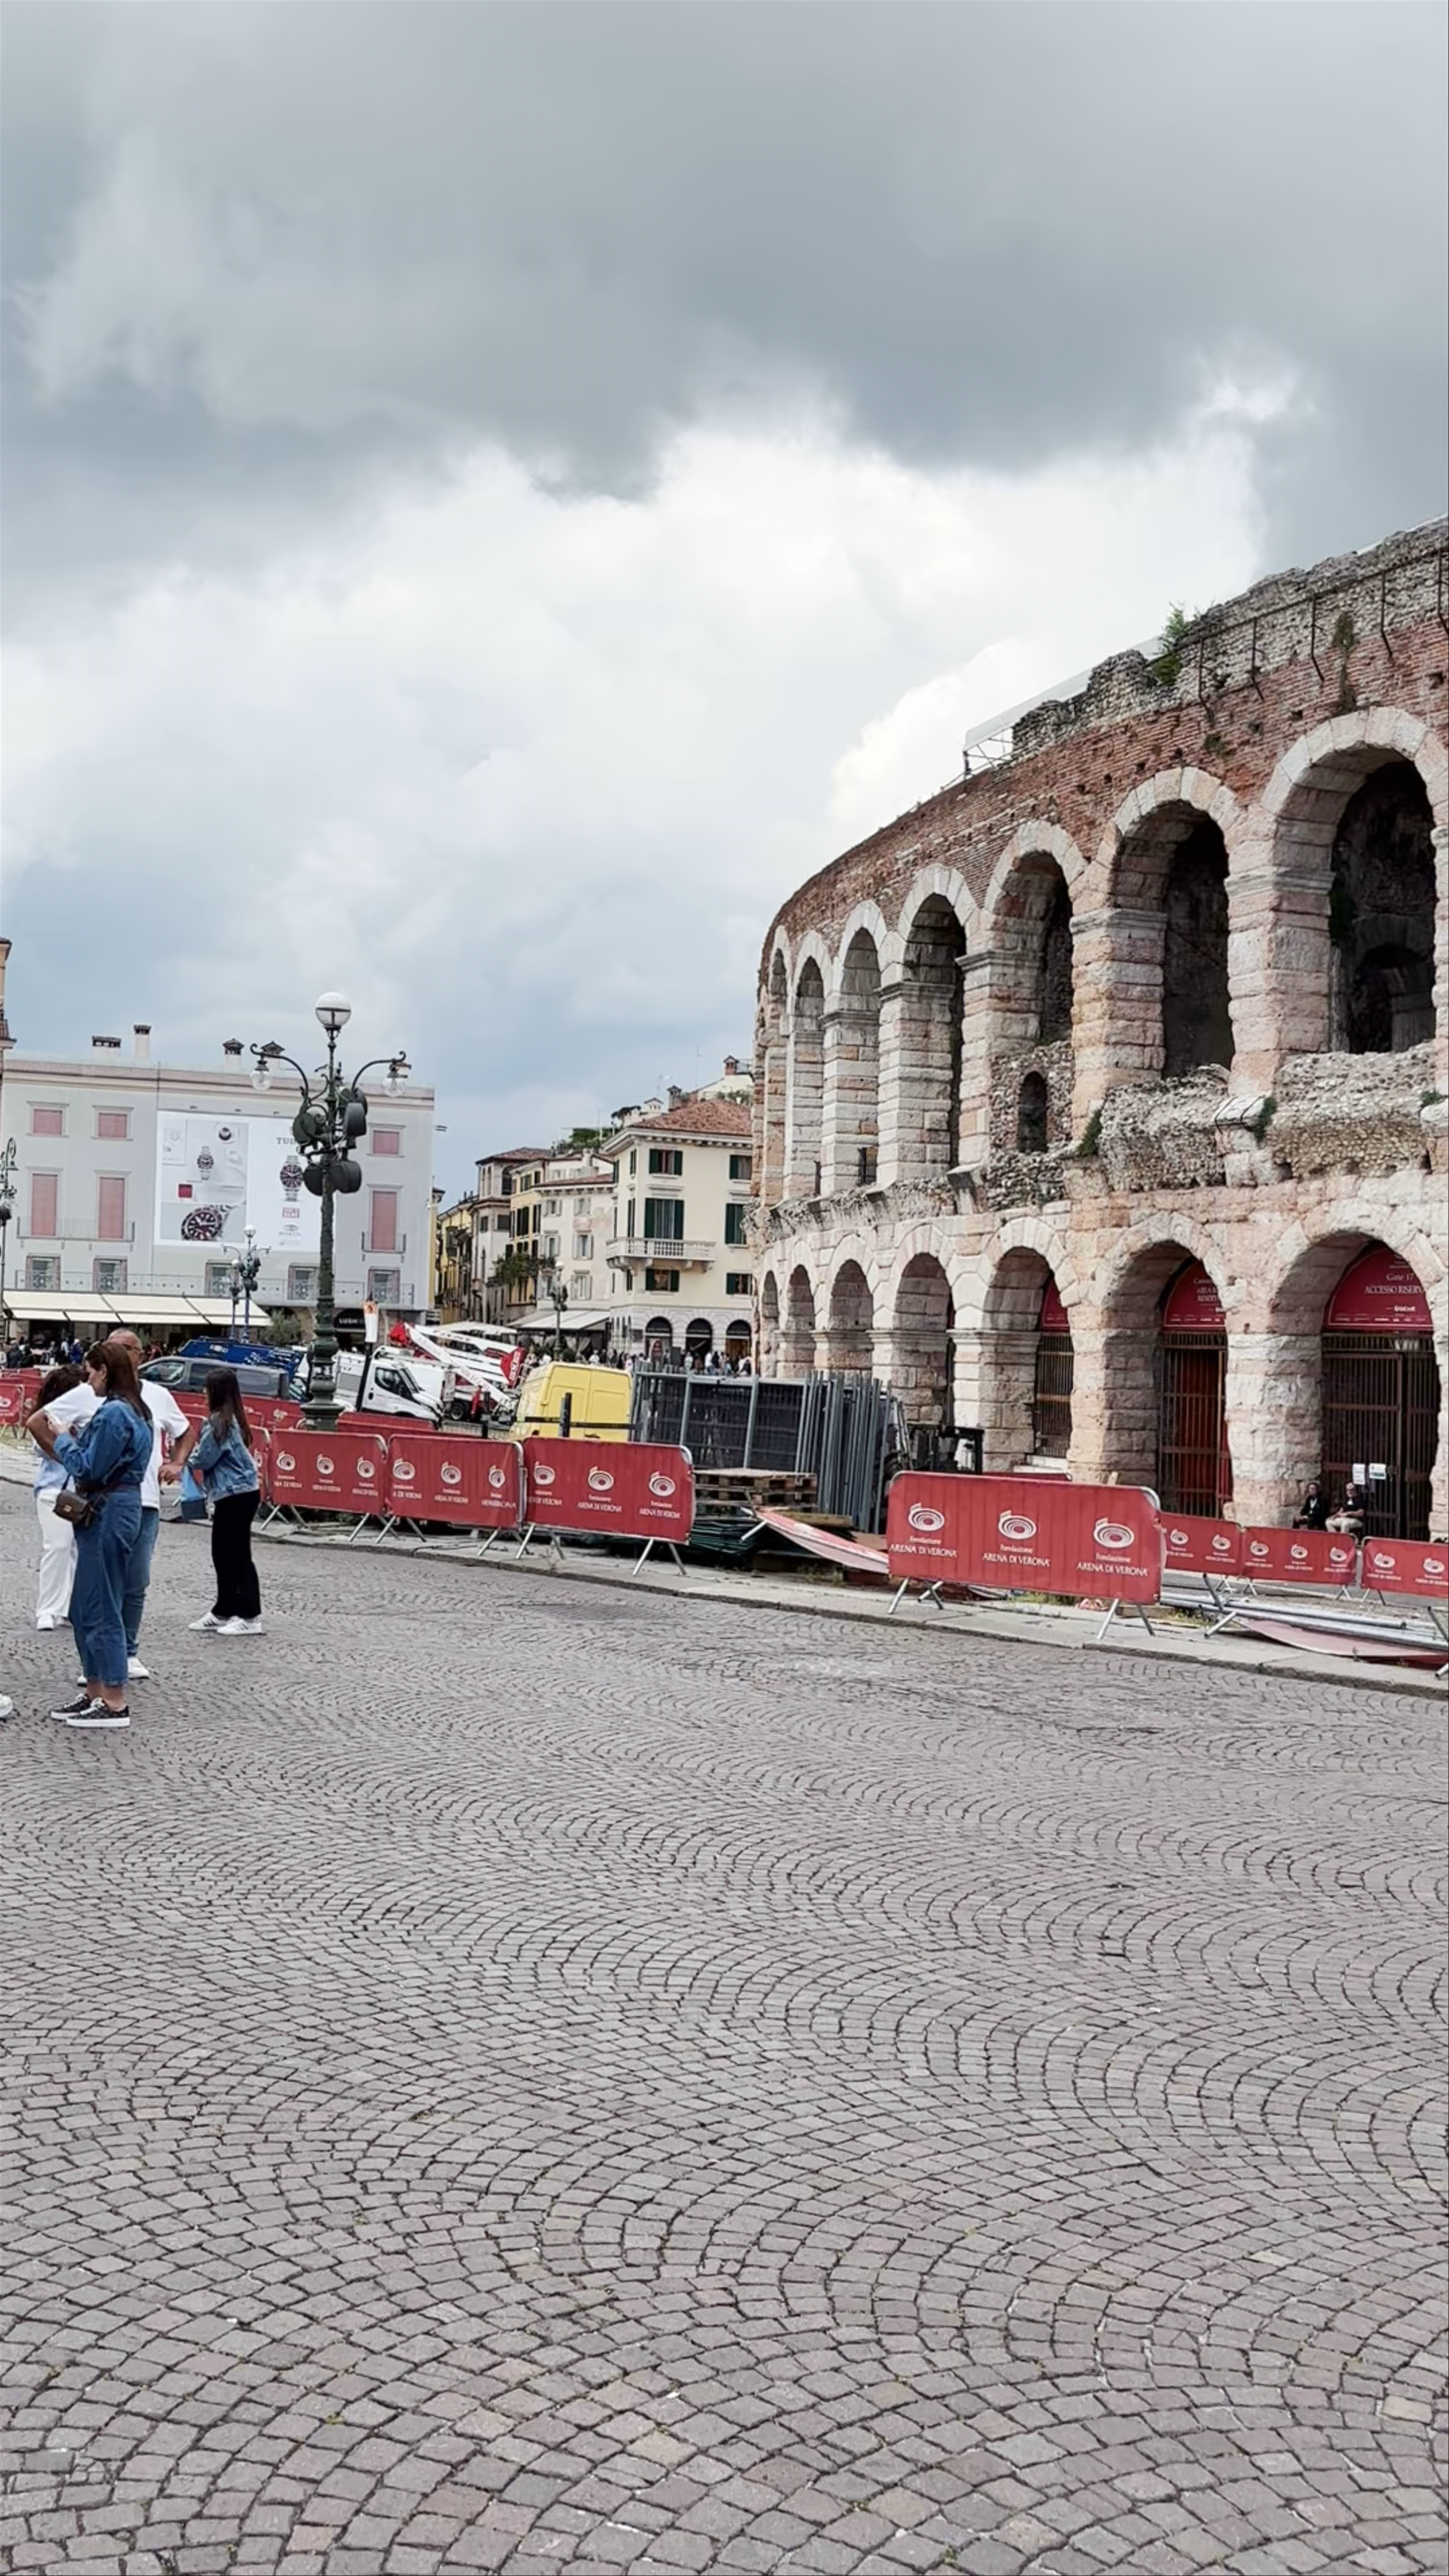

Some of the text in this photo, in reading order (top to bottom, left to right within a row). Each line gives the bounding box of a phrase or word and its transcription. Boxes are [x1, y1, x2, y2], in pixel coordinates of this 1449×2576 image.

[1364, 1285, 1396, 1294] ACCESSO
[889, 1544, 917, 1553] ARENA
[928, 1547, 957, 1557] VERONA
[983, 1553, 1050, 1566] ARENA DI VERONA
[1077, 1562, 1148, 1576] ARENA DI VERONA
